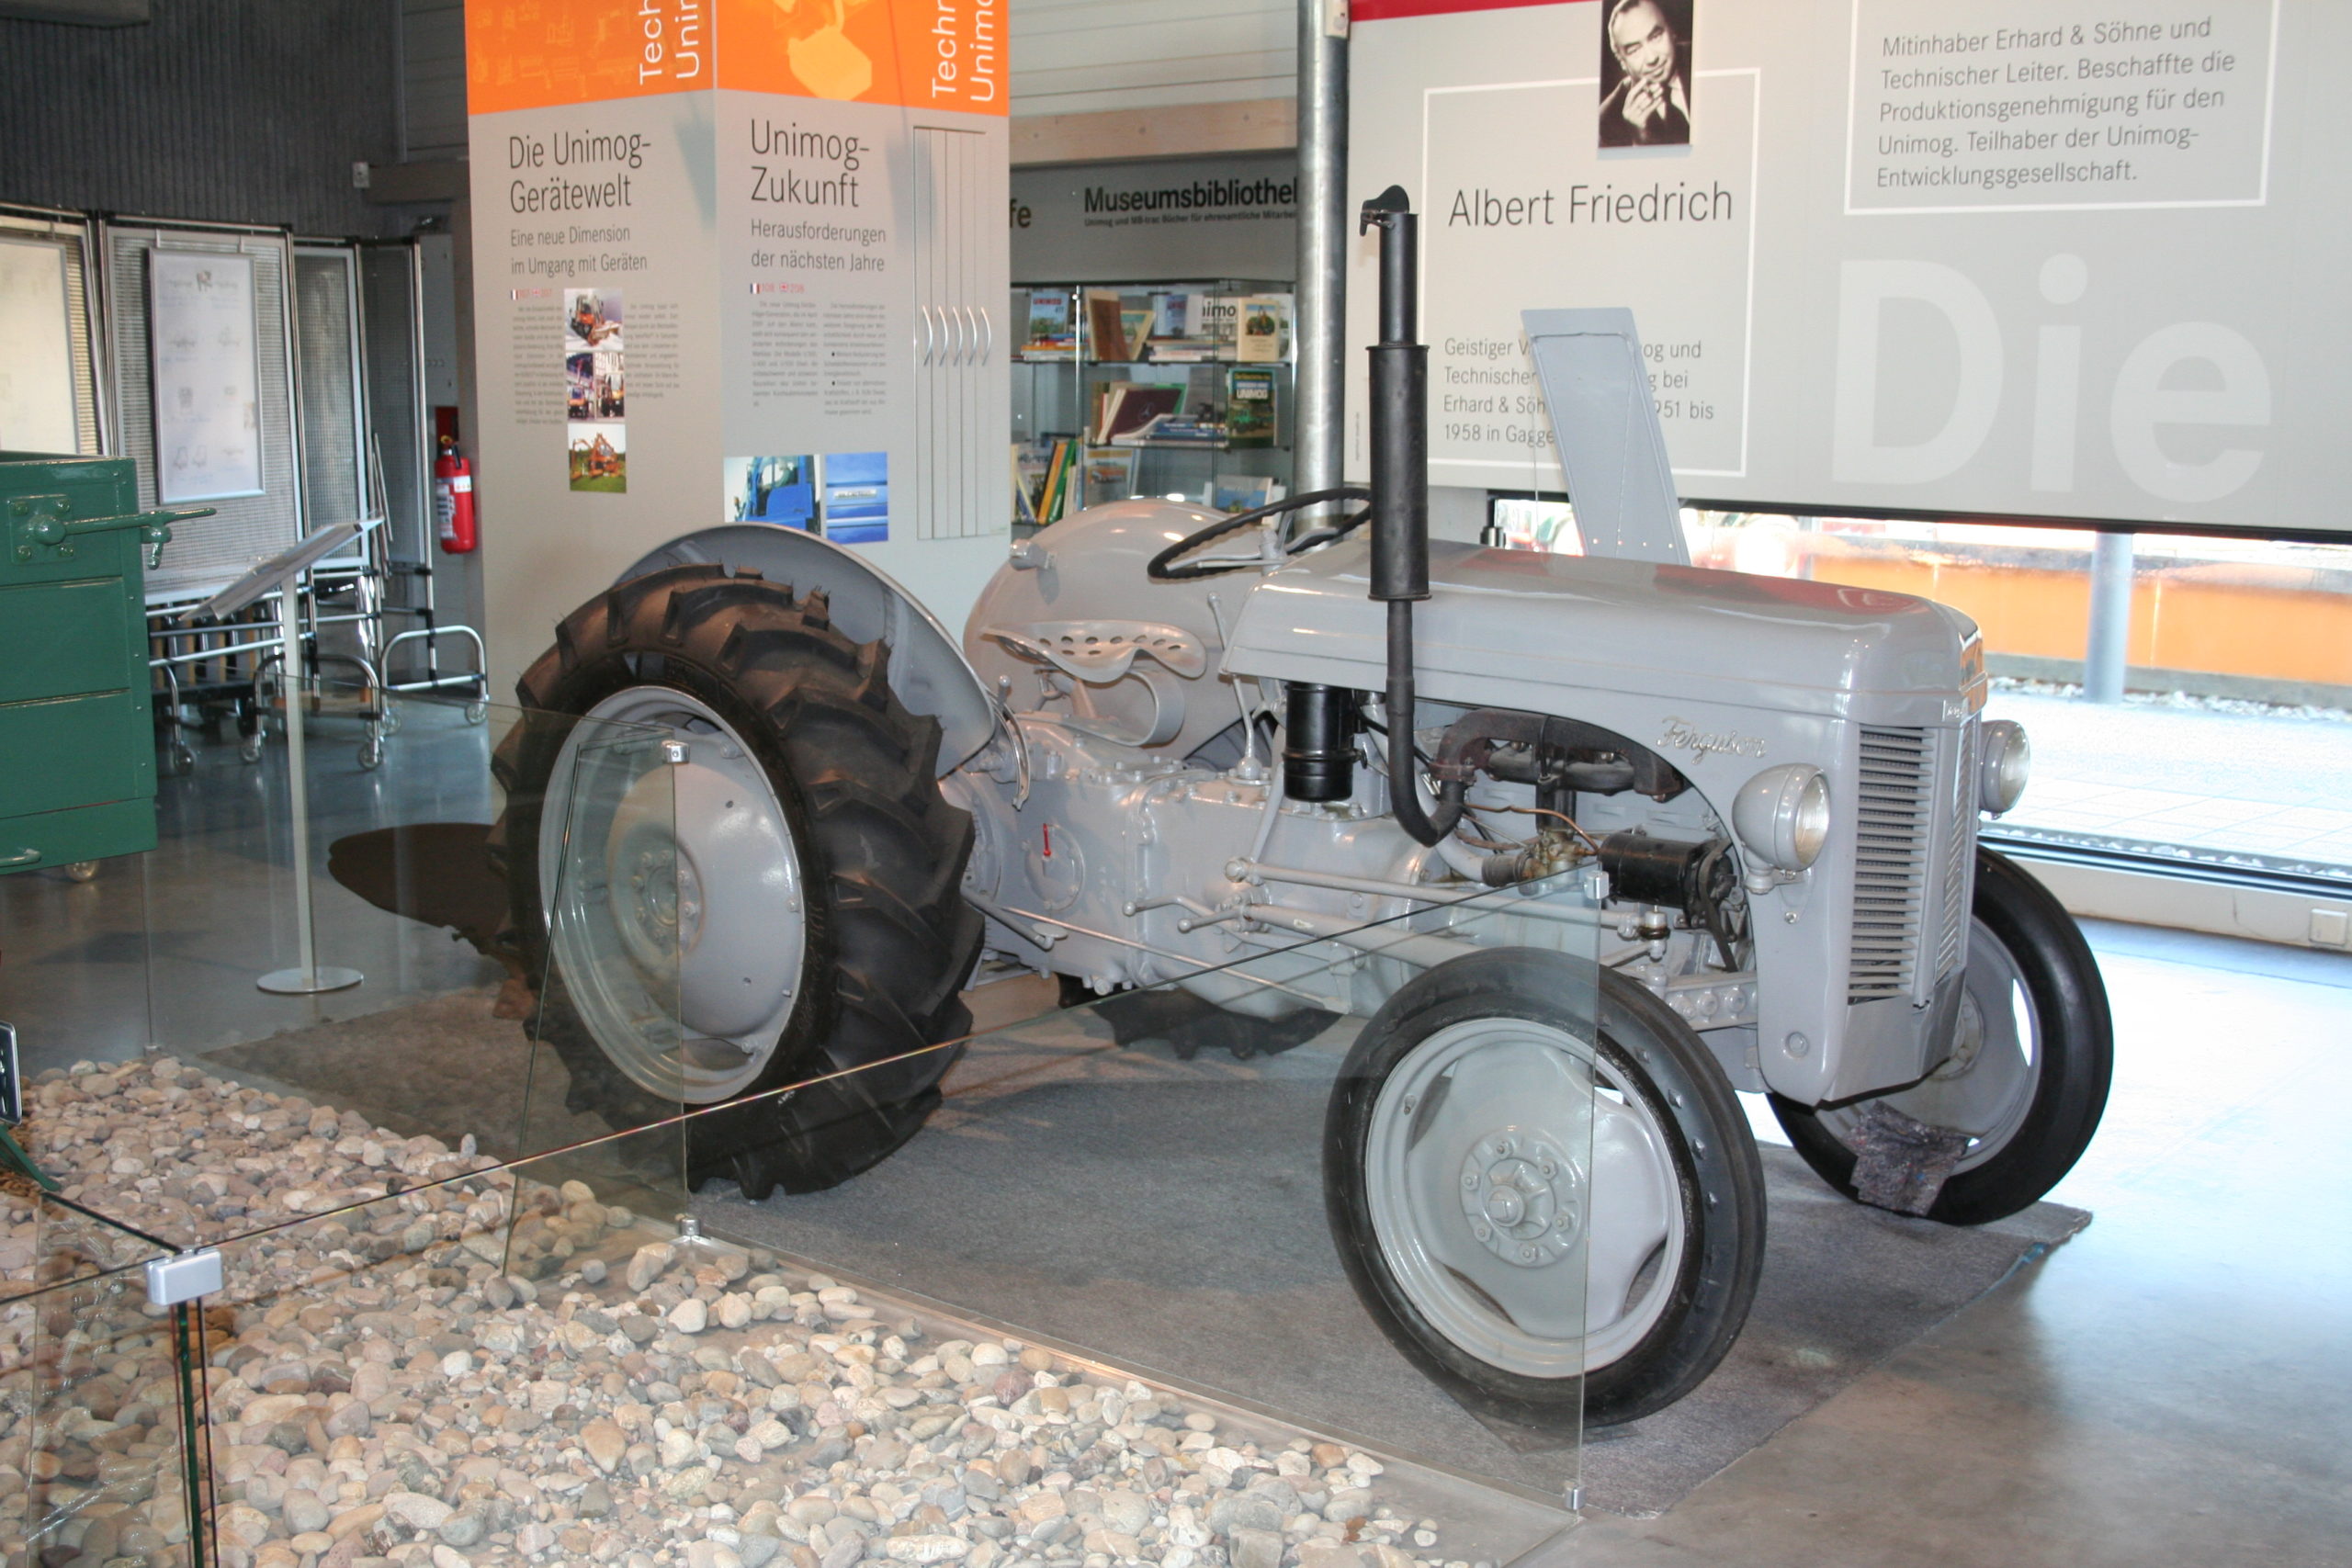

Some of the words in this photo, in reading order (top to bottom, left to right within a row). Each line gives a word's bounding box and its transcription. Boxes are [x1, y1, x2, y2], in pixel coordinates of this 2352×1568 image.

[1883, 33, 1989, 57] Mitinhaber
[1996, 26, 2063, 51] Erhard
[2070, 25, 2084, 46] &
[2094, 21, 2162, 44] Söhne
[2170, 16, 2211, 39] und
[1882, 66, 1999, 90] Technischer
[2007, 61, 2069, 84] Leiter.
[2077, 52, 2194, 80] Beschaffte
[2201, 50, 2235, 73] die
[1880, 92, 2139, 123] Produktionsgenehmigung
[2146, 88, 2177, 111] für
[2183, 87, 2224, 109] den
[509, 134, 544, 169] Die
[554, 129, 651, 169] Unimog-
[751, 118, 869, 171] Unimog-
[1878, 134, 1959, 158] Unimog.
[1967, 130, 2058, 152] Teilhaber
[2064, 127, 2099, 149] der
[2107, 125, 2199, 150] Unimog-
[751, 166, 859, 208] Zukunft
[1877, 159, 2138, 190] Entwicklungsgesellschaft.
[510, 172, 631, 213] Gerätewelt
[1448, 188, 1555, 227] Albert
[1569, 181, 1732, 224] Friedrich
[511, 229, 534, 247] Eine
[537, 231, 565, 245] neue
[569, 224, 630, 244] Dimension
[751, 219, 887, 247] Herausforderungen
[511, 257, 525, 275] im
[528, 257, 575, 278] Umgang
[578, 254, 596, 272] mit
[600, 253, 648, 272] Geräten
[751, 249, 775, 267] der
[780, 250, 844, 270] nächsten
[850, 253, 885, 273] Jahre
[1444, 337, 1513, 360] Geistiger
[1669, 340, 1701, 358] und
[1444, 366, 1536, 385] Technischer
[1663, 369, 1688, 389] bei
[1832, 254, 2271, 502] Die
[1443, 394, 1493, 413] Erhard
[1498, 396, 1509, 413] &
[1516, 396, 1545, 414] Söh
[1654, 400, 1679, 419] 951
[1690, 400, 1714, 420] bis
[1445, 423, 1481, 442] 1958
[1487, 423, 1500, 442] in
[1506, 424, 1555, 448] Gagge
[1656, 715, 1767, 764] Ferguson
